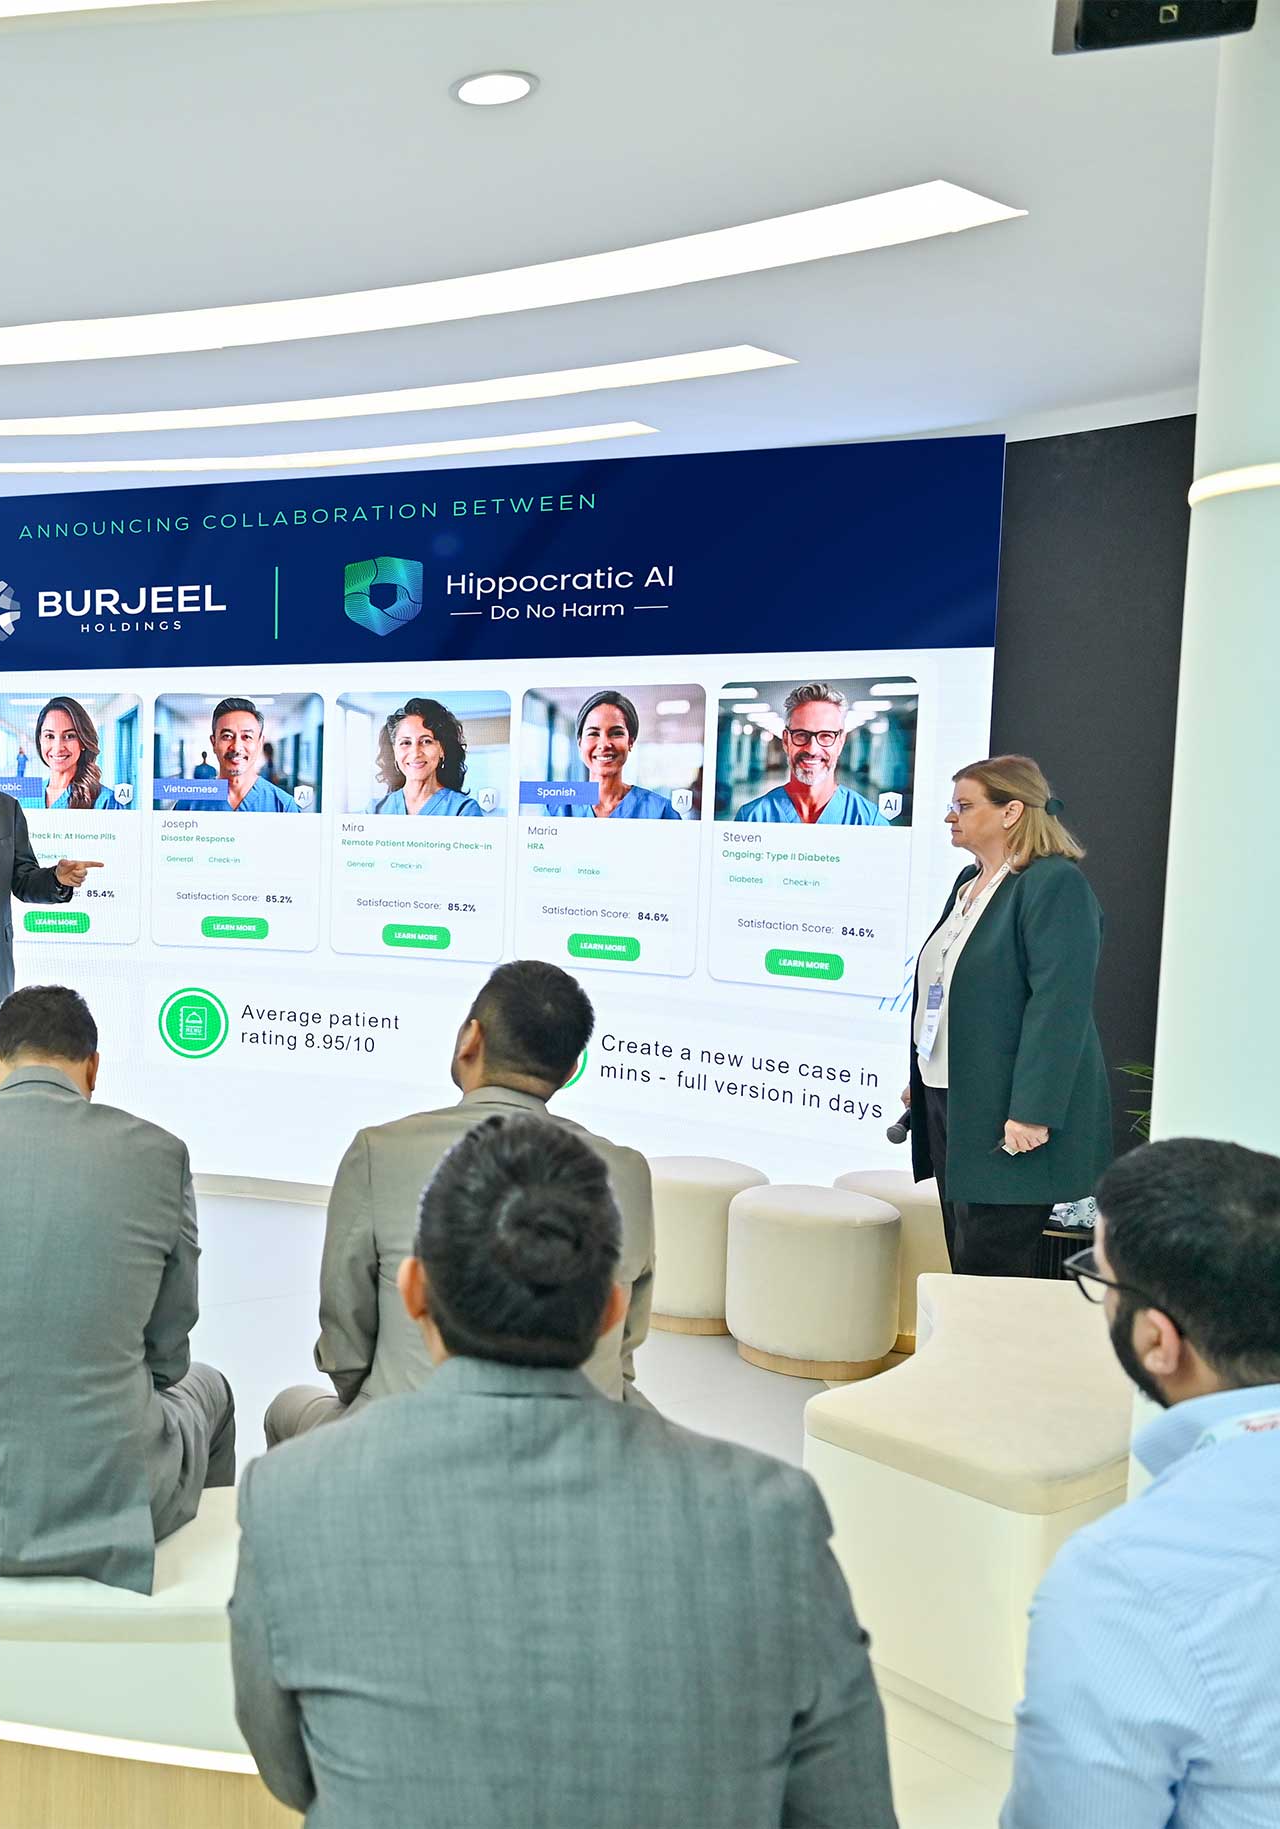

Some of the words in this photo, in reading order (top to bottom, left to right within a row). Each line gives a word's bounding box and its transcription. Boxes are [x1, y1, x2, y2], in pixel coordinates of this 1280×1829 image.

[18, 516, 190, 540] ANNOUNCING
[202, 501, 437, 530] COLLABORATION
[452, 493, 596, 517] BETWEEN
[446, 566, 634, 600] Hippocratic
[644, 565, 674, 587] AI
[37, 584, 227, 618] BURJEEL
[490, 605, 520, 620] Do
[526, 604, 556, 619] No
[562, 602, 625, 618] Harm
[80, 620, 182, 633] HOLDINGS
[162, 785, 218, 794] Vietnamese
[536, 788, 576, 798] Spanish
[482, 794, 494, 805] AI
[676, 796, 688, 806] AI
[884, 799, 898, 811] AI
[161, 820, 198, 830] Joseph
[342, 823, 365, 832] Mira
[64, 832, 74, 840] At
[100, 832, 116, 840] Pills
[528, 826, 558, 836] Maria
[160, 834, 194, 842] Disaster
[196, 836, 236, 844] Response
[722, 832, 762, 843] Steven
[341, 838, 374, 847] Remote
[376, 840, 405, 848] Patient
[406, 840, 451, 851] Monitoring
[527, 842, 544, 850] HRA
[208, 856, 240, 864] Check-in
[722, 850, 764, 862] Ongoing:
[766, 852, 788, 862] Type
[798, 853, 840, 863] Diabetes
[346, 860, 375, 868] General
[532, 866, 562, 874] General
[578, 868, 600, 876] Intake
[728, 875, 763, 884] Diabetes
[782, 878, 820, 887] Check-in
[86, 890, 115, 898] 85.4%
[176, 891, 230, 902] Satisfaction
[231, 893, 260, 902] Score:
[266, 895, 292, 904] 85.2%
[356, 898, 412, 909] Satisfaction
[413, 900, 442, 910] Score:
[448, 903, 476, 912] 85.2%
[542, 905, 598, 917] Satisfaction
[600, 909, 631, 920] Score:
[637, 912, 669, 922] 84.6%
[236, 924, 256, 932] MORE
[738, 918, 799, 932] Satisfaction
[802, 922, 834, 934] Score:
[841, 926, 874, 938] 84.6%
[394, 932, 416, 940] LEARN
[417, 933, 438, 942] MORE
[580, 942, 604, 950] LEARN
[604, 943, 627, 952] MORE
[778, 958, 805, 968] LEARN
[806, 960, 830, 970] MORE
[241, 1004, 322, 1028] Average
[328, 1012, 400, 1030] patient
[241, 1030, 298, 1050] rating
[304, 1032, 375, 1053] 8.95/10
[601, 1034, 672, 1058] Create
[680, 1047, 692, 1061] a
[700, 1050, 743, 1068] new
[752, 1056, 790, 1074] use
[798, 1062, 851, 1083] case
[860, 1068, 878, 1088] in
[600, 1062, 651, 1083] mins
[676, 1070, 707, 1092] full
[715, 1079, 794, 1104] version
[802, 1088, 820, 1108] in
[829, 1094, 883, 1121] days
